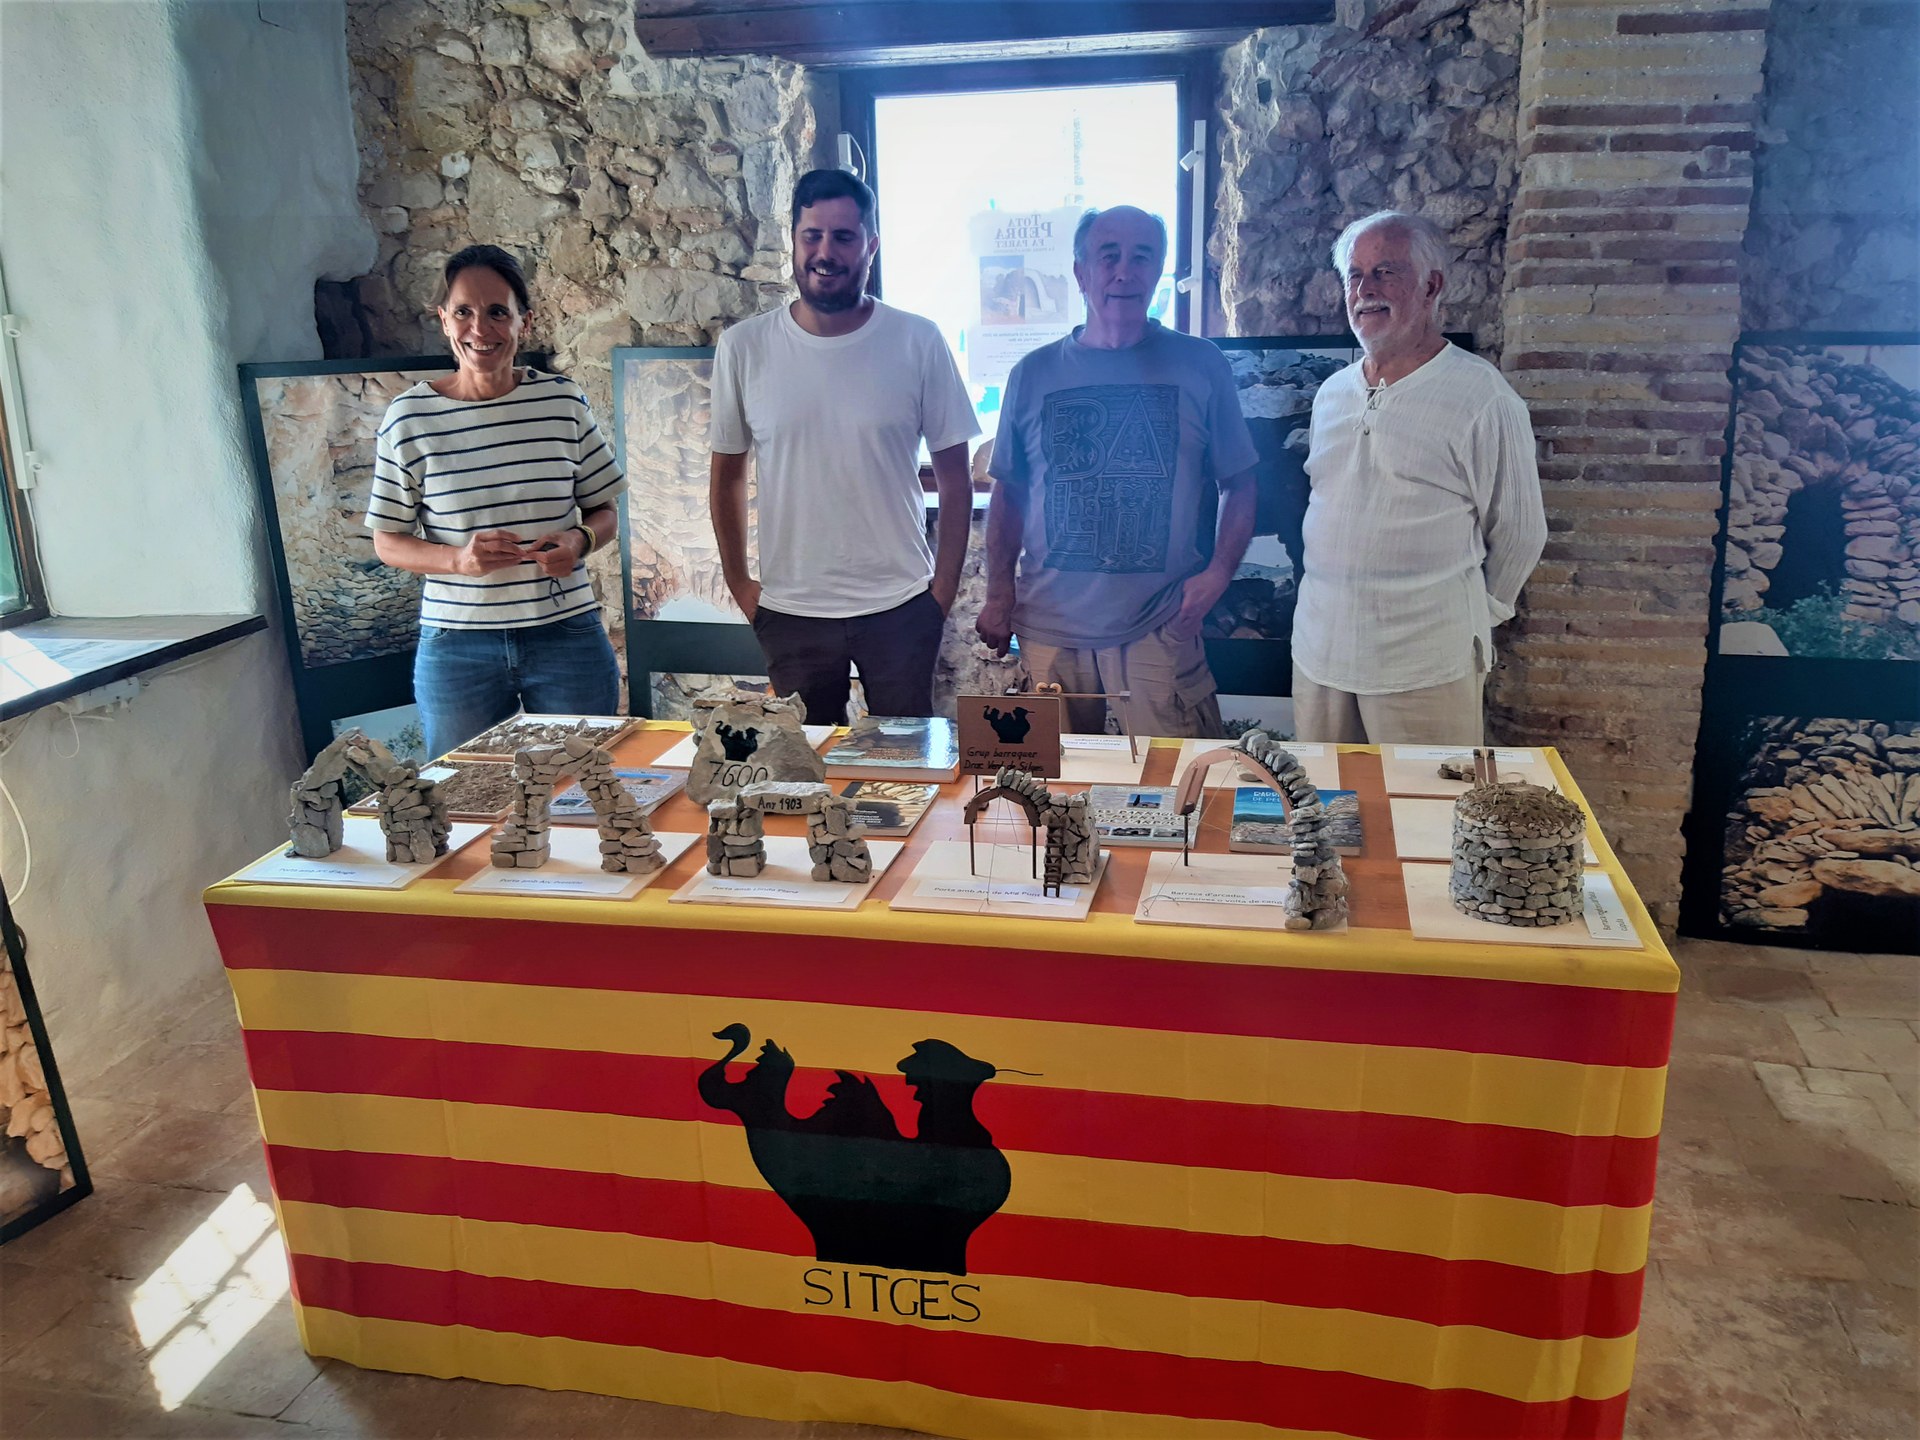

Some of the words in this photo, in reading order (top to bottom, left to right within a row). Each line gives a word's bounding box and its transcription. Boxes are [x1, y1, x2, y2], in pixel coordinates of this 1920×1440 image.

[967, 746, 990, 758] Grup
[993, 748, 1038, 760] barraquer
[964, 759, 984, 770] Drac
[1007, 760, 1016, 770] de
[779, 797, 802, 810] 1903
[1021, 890, 1041, 898] Punt
[1170, 889, 1203, 897] Barraca
[1204, 891, 1246, 899] d'arcades
[803, 1267, 981, 1323] SITGES
